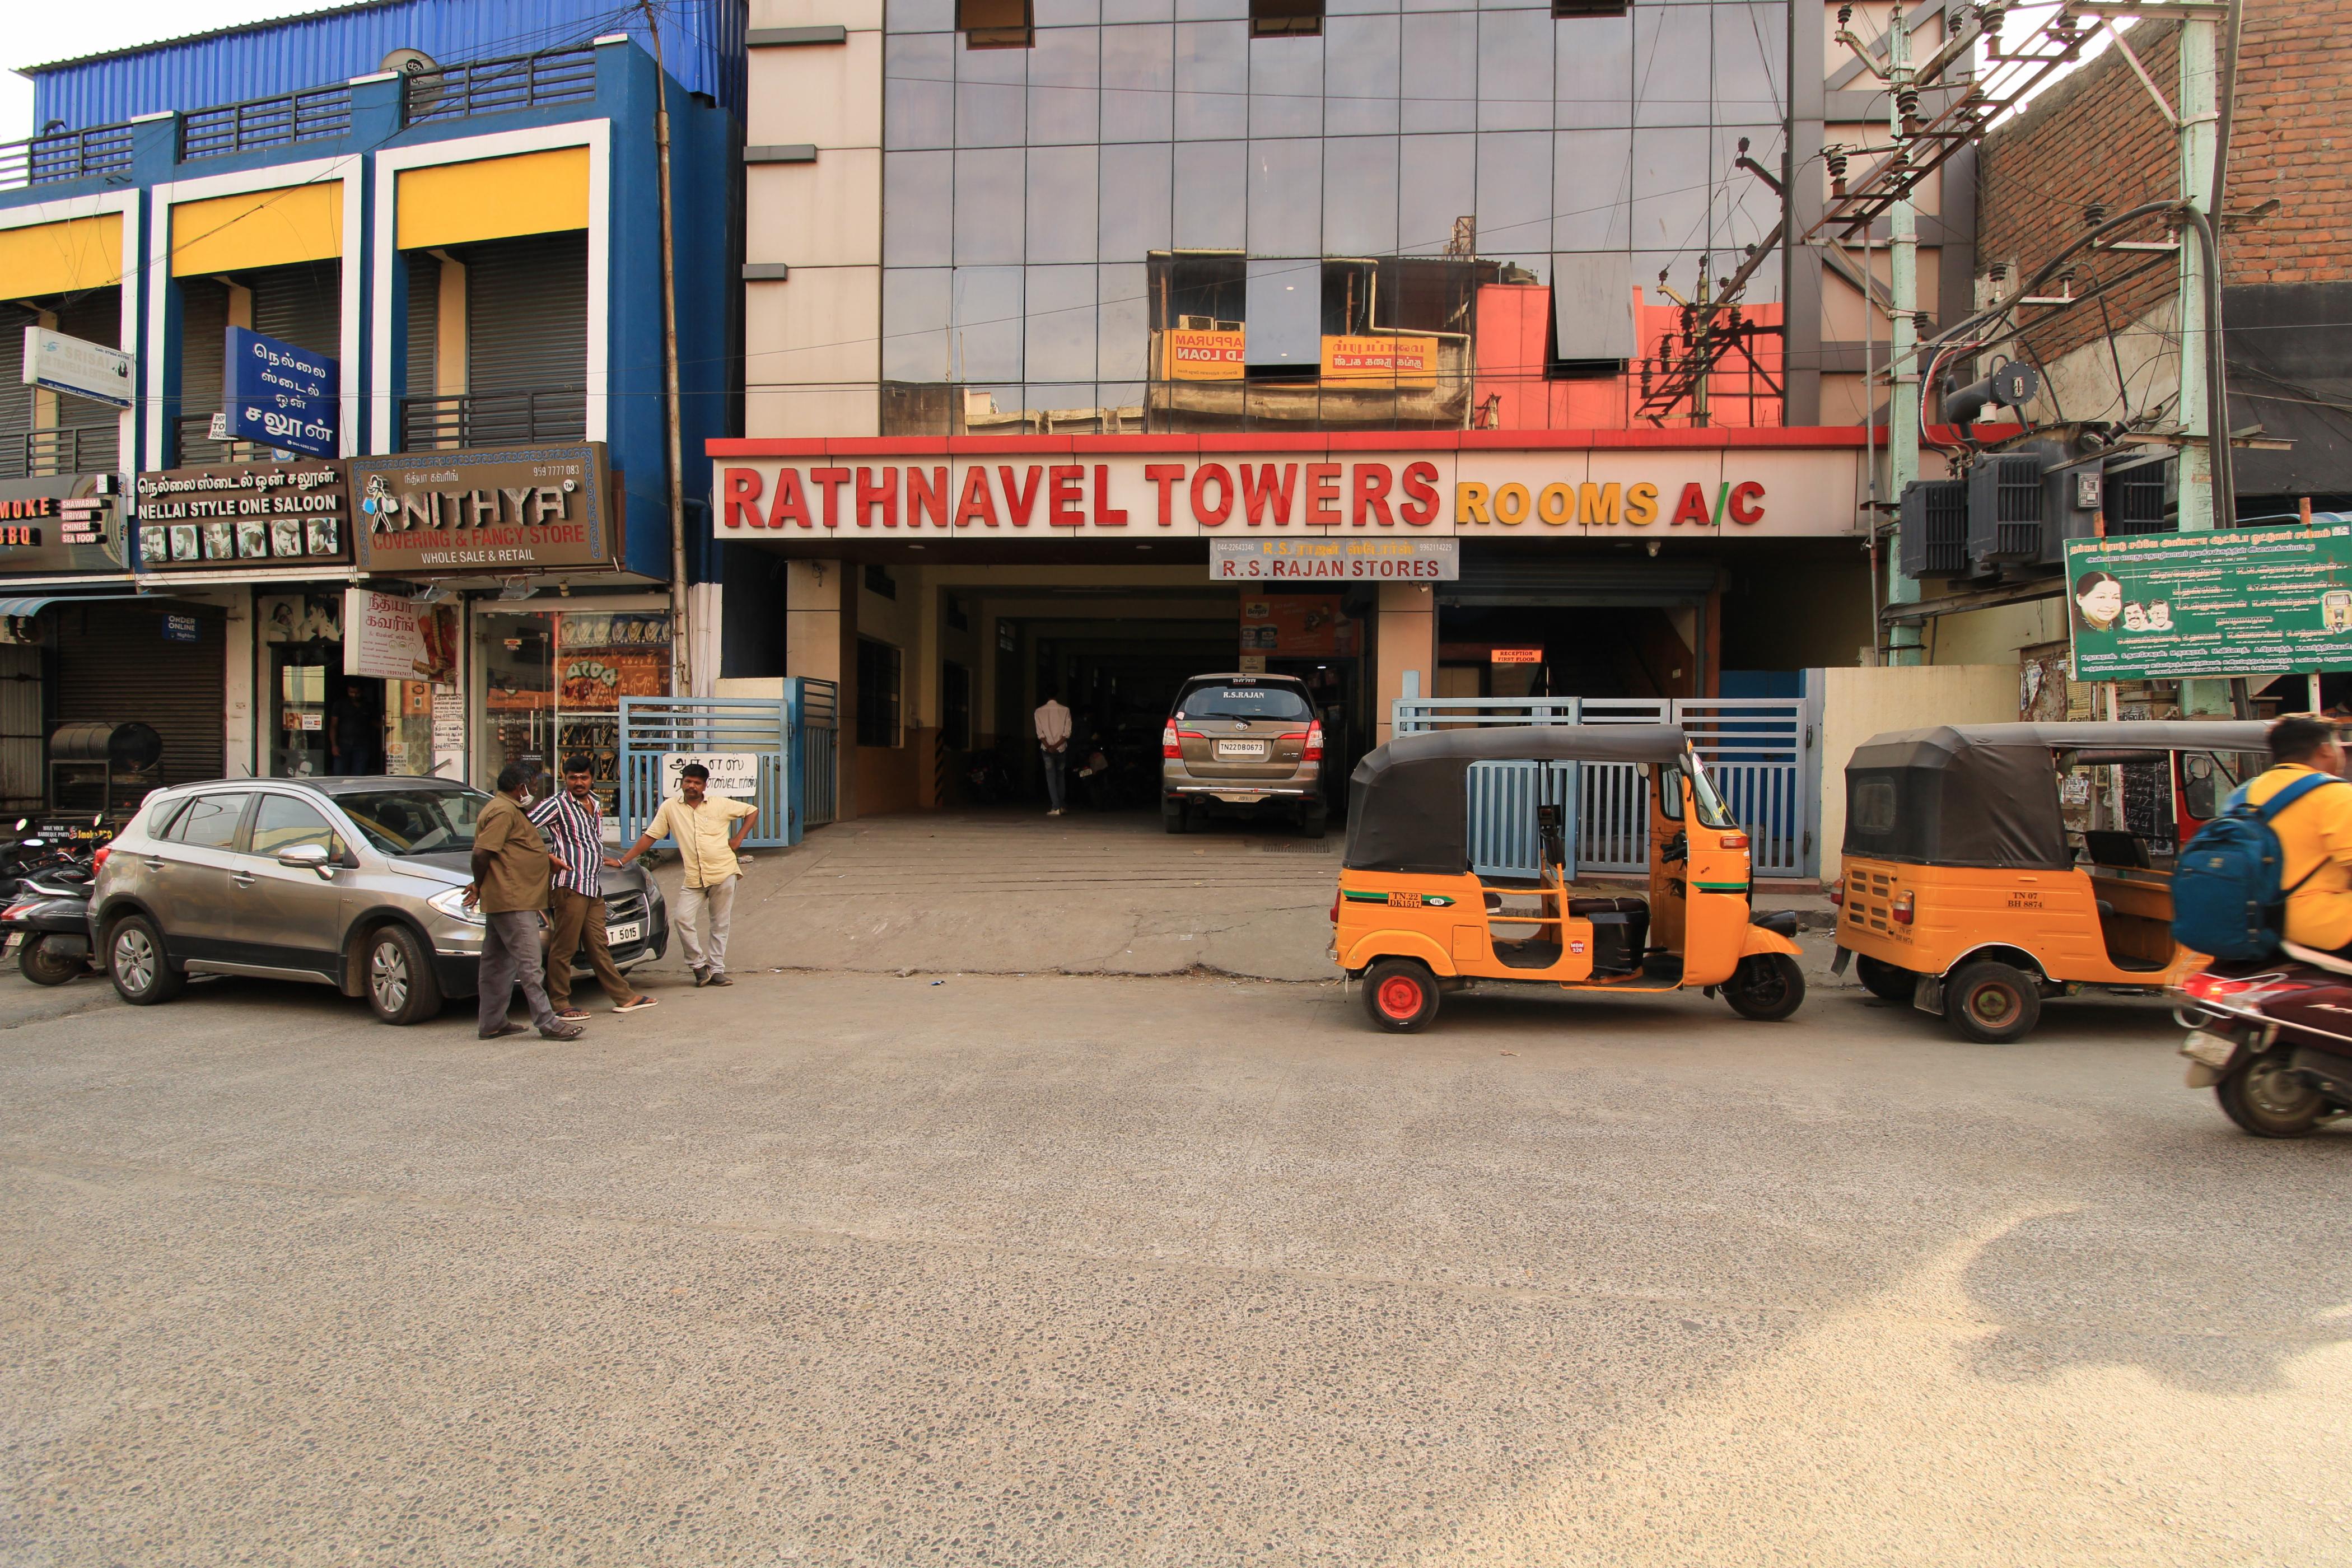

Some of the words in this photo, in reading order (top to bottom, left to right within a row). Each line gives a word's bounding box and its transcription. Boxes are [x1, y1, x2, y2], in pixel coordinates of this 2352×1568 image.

[254, 343, 326, 379] நெல்லை
[262, 368, 319, 397] ஸ்டைல்
[276, 394, 306, 409] ஒன்
[245, 406, 333, 442] சலூன்
[533, 466, 547, 477] 959
[548, 465, 564, 476] 7777
[566, 465, 579, 475] 083
[138, 475, 196, 499] நெல்லை
[197, 470, 253, 494] ஸ்டைல்
[255, 468, 285, 493] ஒன்
[724, 465, 1127, 528] RATHNAVEL
[1145, 461, 1440, 526] TOWERS
[1456, 482, 1658, 525] ROOMS
[1671, 481, 1766, 525] A/C
[62, 498, 102, 509] SHAWARMA
[138, 502, 186, 520] NELLAI
[190, 500, 235, 518] STYLE
[239, 498, 270, 515] ONE
[274, 494, 336, 512] SALOON
[402, 486, 566, 530] NITHYA
[62, 511, 91, 520] BIRIYANI
[62, 522, 91, 531] CHINESE
[62, 534, 76, 543] SEA
[76, 533, 96, 543] FOOD
[372, 530, 451, 551] COVERING
[455, 530, 468, 548] &
[472, 526, 524, 546] FANCY
[530, 524, 585, 544] STORE
[1263, 542, 1291, 555] R.S.
[1296, 540, 1341, 556] ராஜன்
[1347, 540, 1416, 556] ஸ்டோர்ஸ்
[421, 550, 458, 564] WHOLE
[459, 550, 485, 563] SALE
[488, 550, 496, 562] &
[498, 549, 535, 561] RETAIL
[1351, 560, 1439, 577] STORES
[367, 593, 413, 614] நித்யா
[169, 615, 195, 624] ORDER
[169, 623, 195, 632] ONLINE
[366, 615, 415, 633] கவரிங்
[1390, 899, 1420, 908] DK1517
[610, 932, 614, 942] T
[619, 927, 637, 940] 5015
